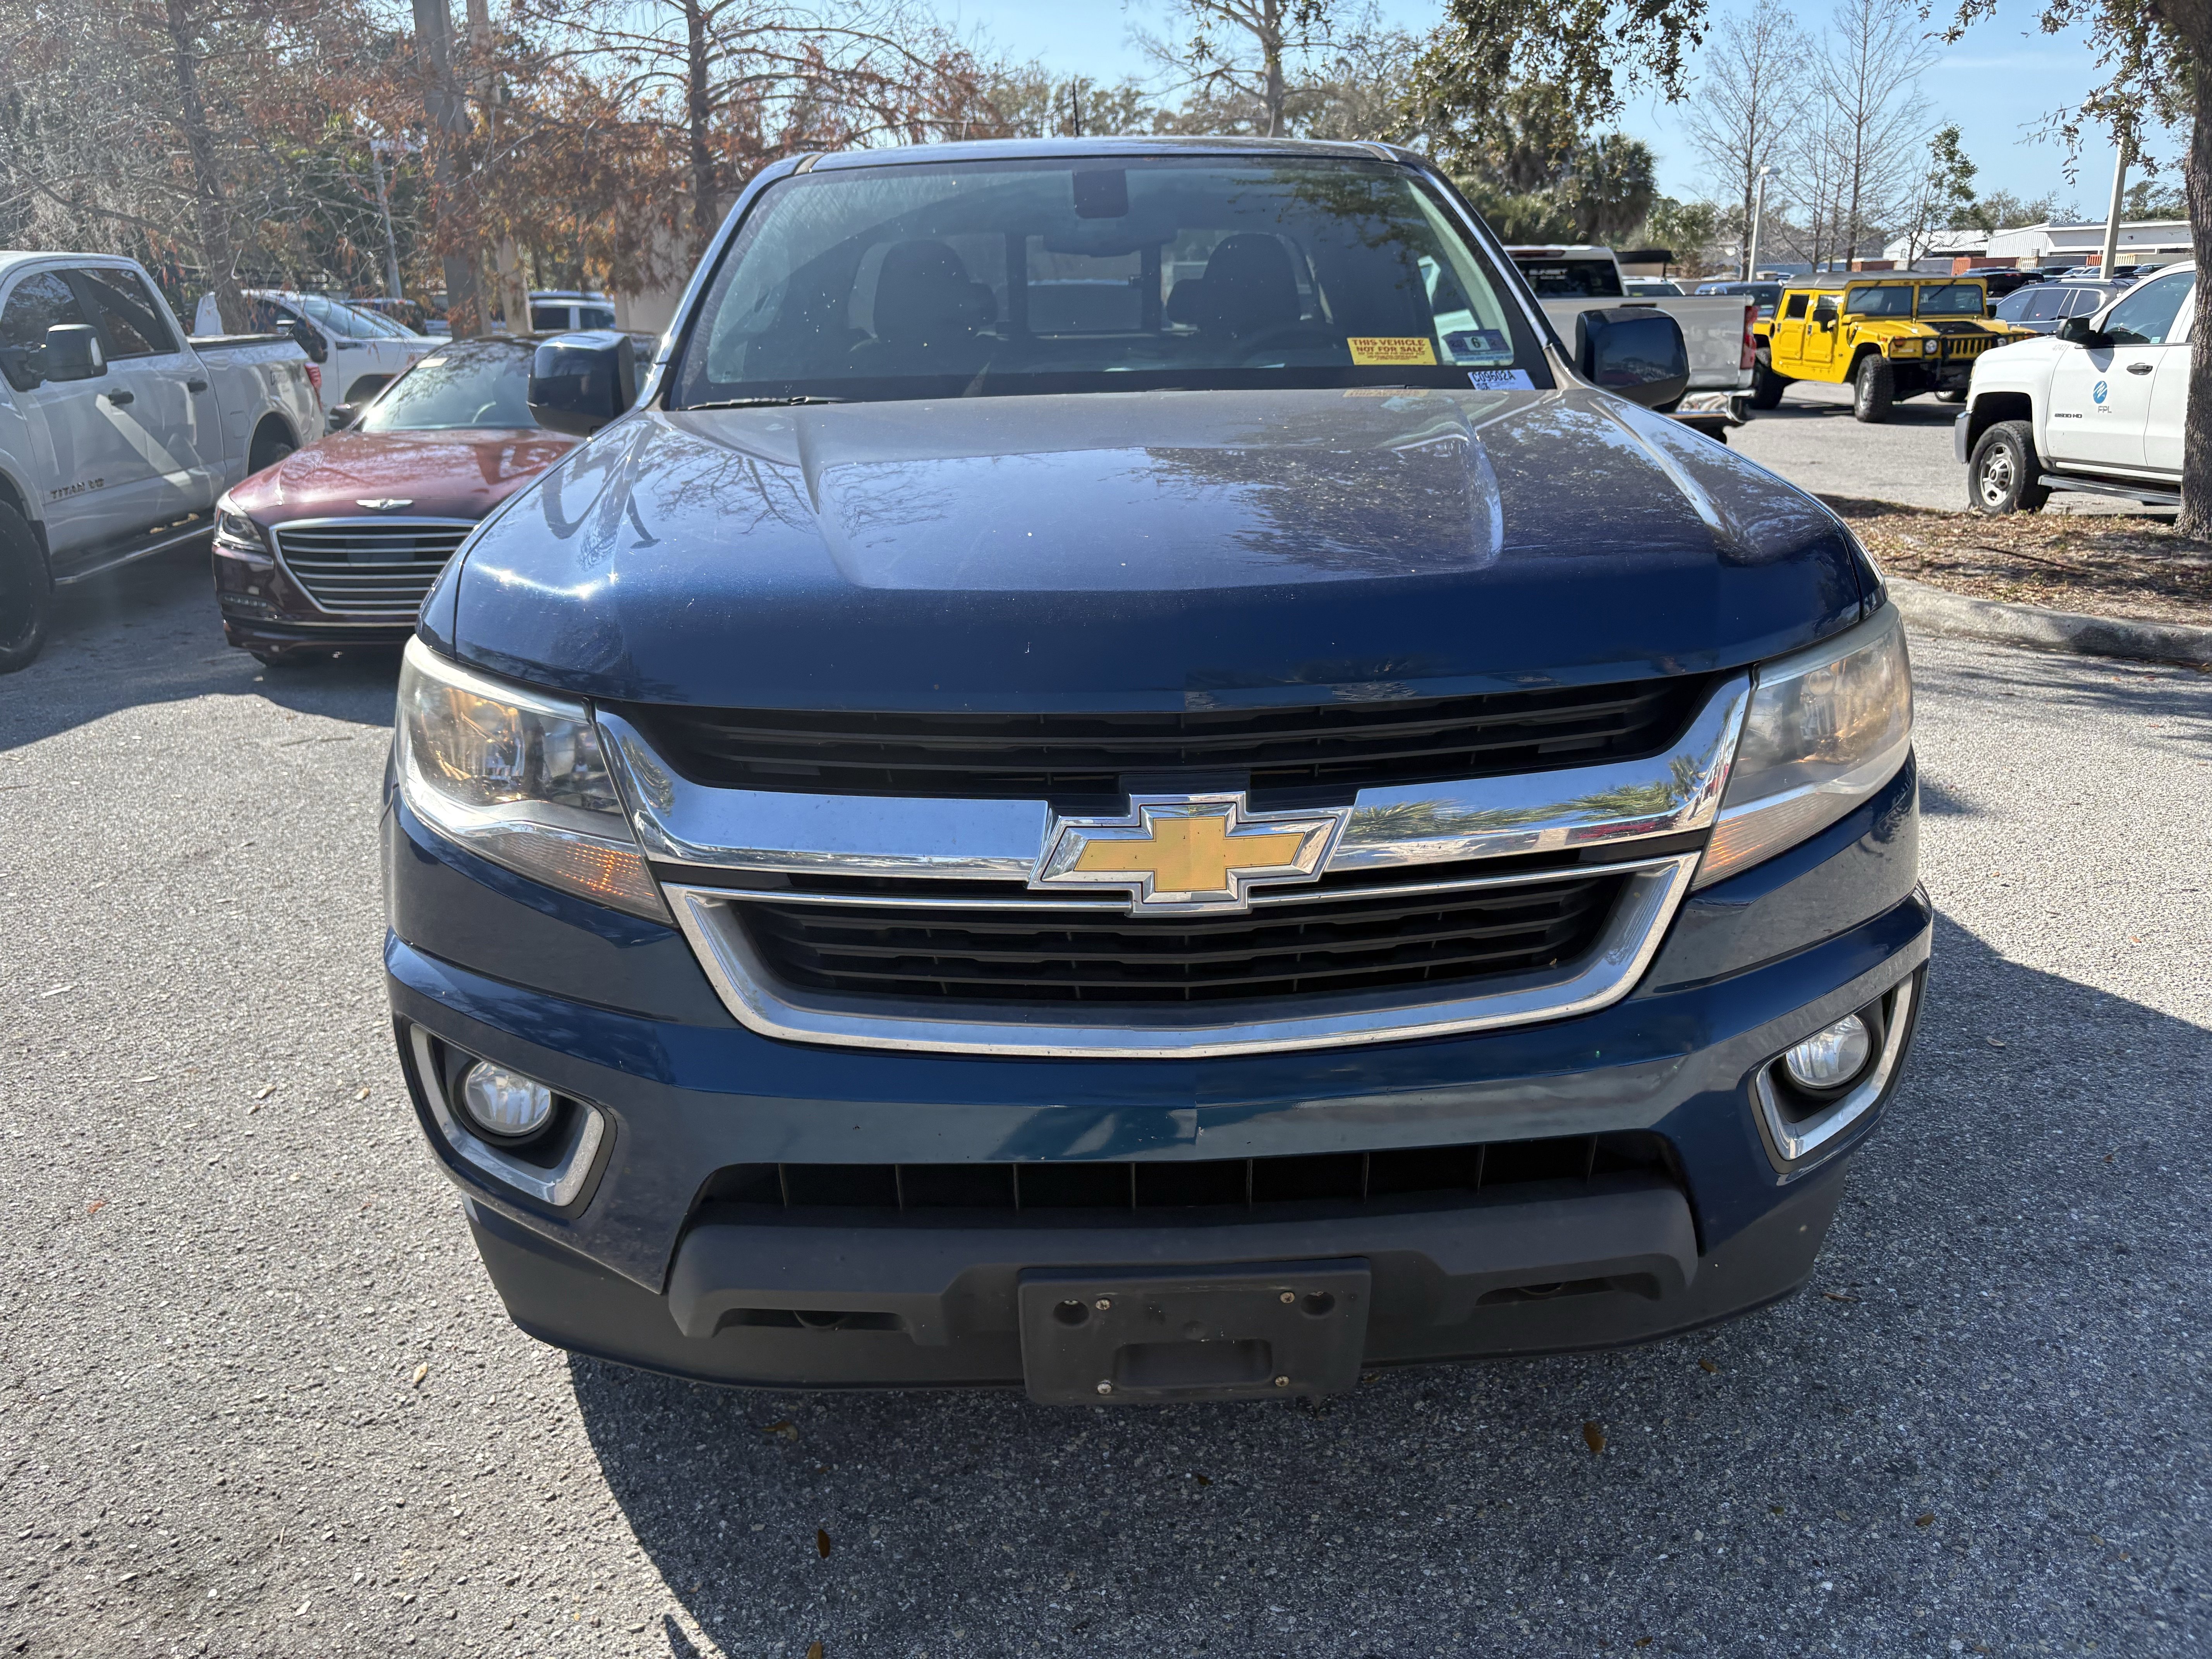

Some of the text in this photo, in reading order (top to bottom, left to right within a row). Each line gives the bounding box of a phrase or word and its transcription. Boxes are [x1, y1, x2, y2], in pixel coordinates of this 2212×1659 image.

[1471, 337, 1481, 348] 6
[1472, 370, 1516, 382] C09602A
[50, 482, 85, 500] TITAN
